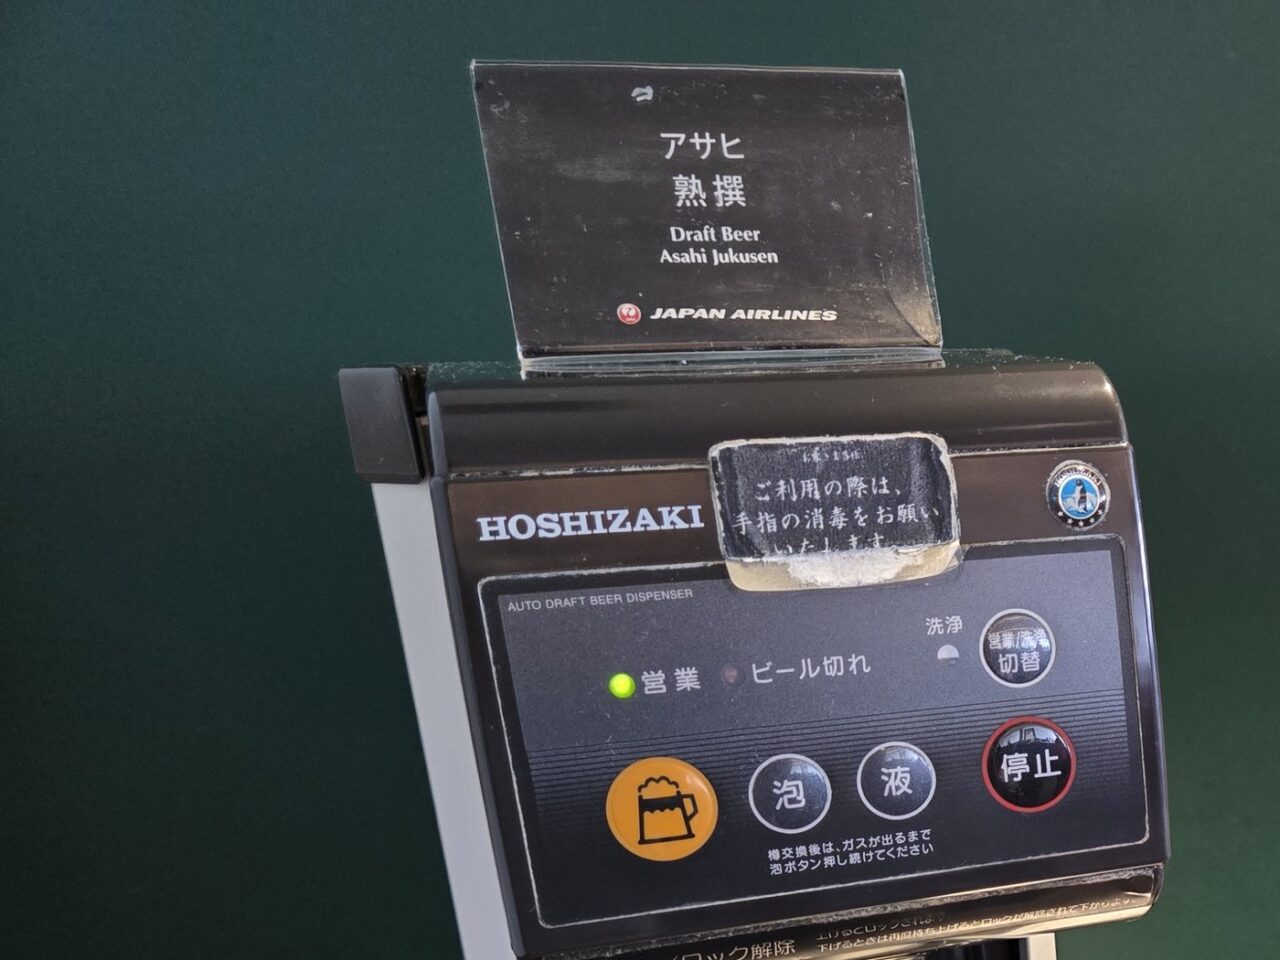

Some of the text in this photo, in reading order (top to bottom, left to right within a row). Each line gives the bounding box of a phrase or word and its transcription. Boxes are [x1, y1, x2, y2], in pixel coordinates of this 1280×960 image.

[659, 132, 746, 161] アサヒ
[669, 225, 761, 243] Draft Beer
[659, 248, 779, 266] Asahi Jukusen
[650, 307, 838, 322] JAPAN AIRLINES
[754, 476, 902, 502] ご利用の際は、
[476, 504, 705, 541] HOSHIZAKI
[732, 502, 940, 535] 手指の消毒をお願い
[507, 588, 694, 612] AUTO DRAFT BEER DISPENSER
[925, 615, 963, 636] 洗浄
[751, 653, 872, 685] ビール切れ
[998, 651, 1041, 674] 切替
[641, 667, 701, 695] 営業
[880, 765, 914, 797] 液
[1000, 750, 1064, 784] 停止
[772, 779, 807, 810] 泡
[769, 842, 935, 876] 泡ボタン押し続けてください
